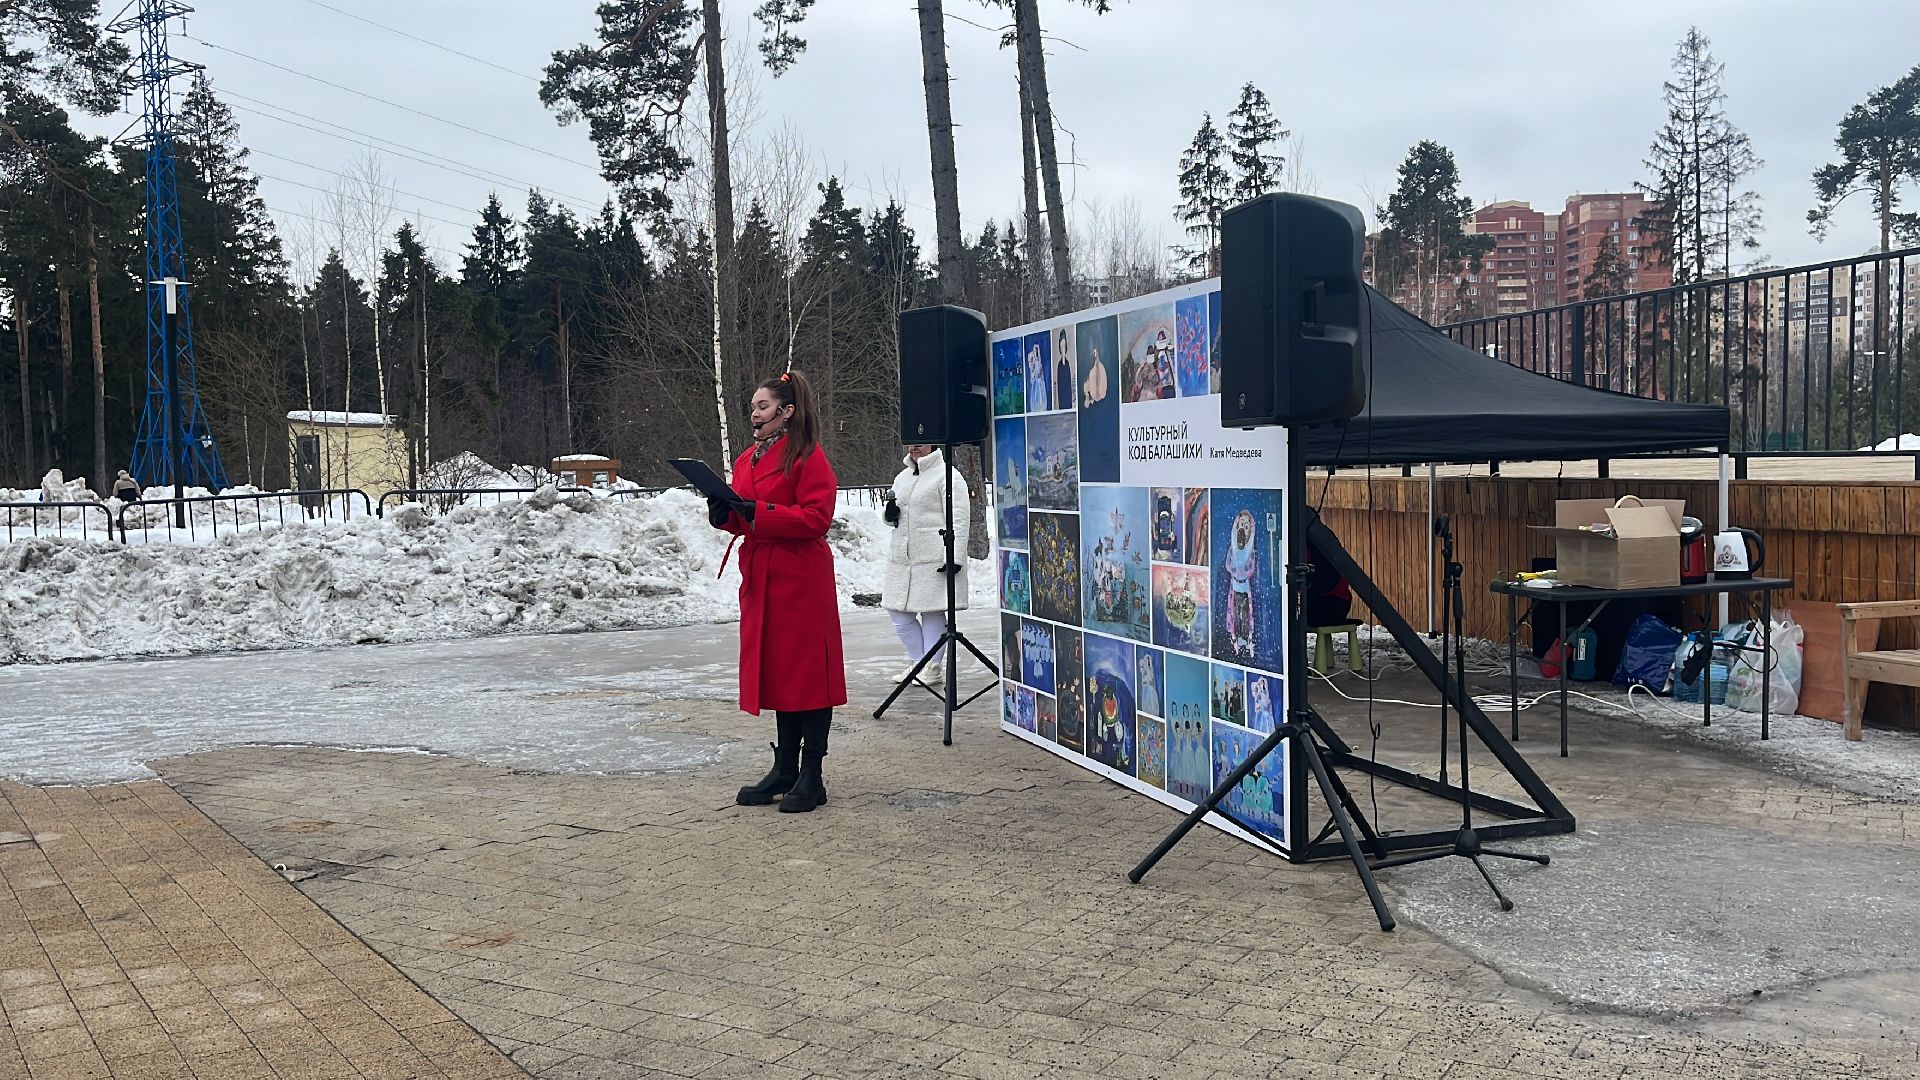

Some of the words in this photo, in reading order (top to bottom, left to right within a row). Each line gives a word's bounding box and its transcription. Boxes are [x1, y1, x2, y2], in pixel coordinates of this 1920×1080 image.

[1128, 421, 1188, 442] КУЛЬТУРНЫЙ
[1128, 445, 1147, 462] КОД
[1148, 443, 1203, 460] БАЛАШИХИ
[1210, 447, 1225, 459] Катя
[1225, 446, 1262, 459] Медведева
